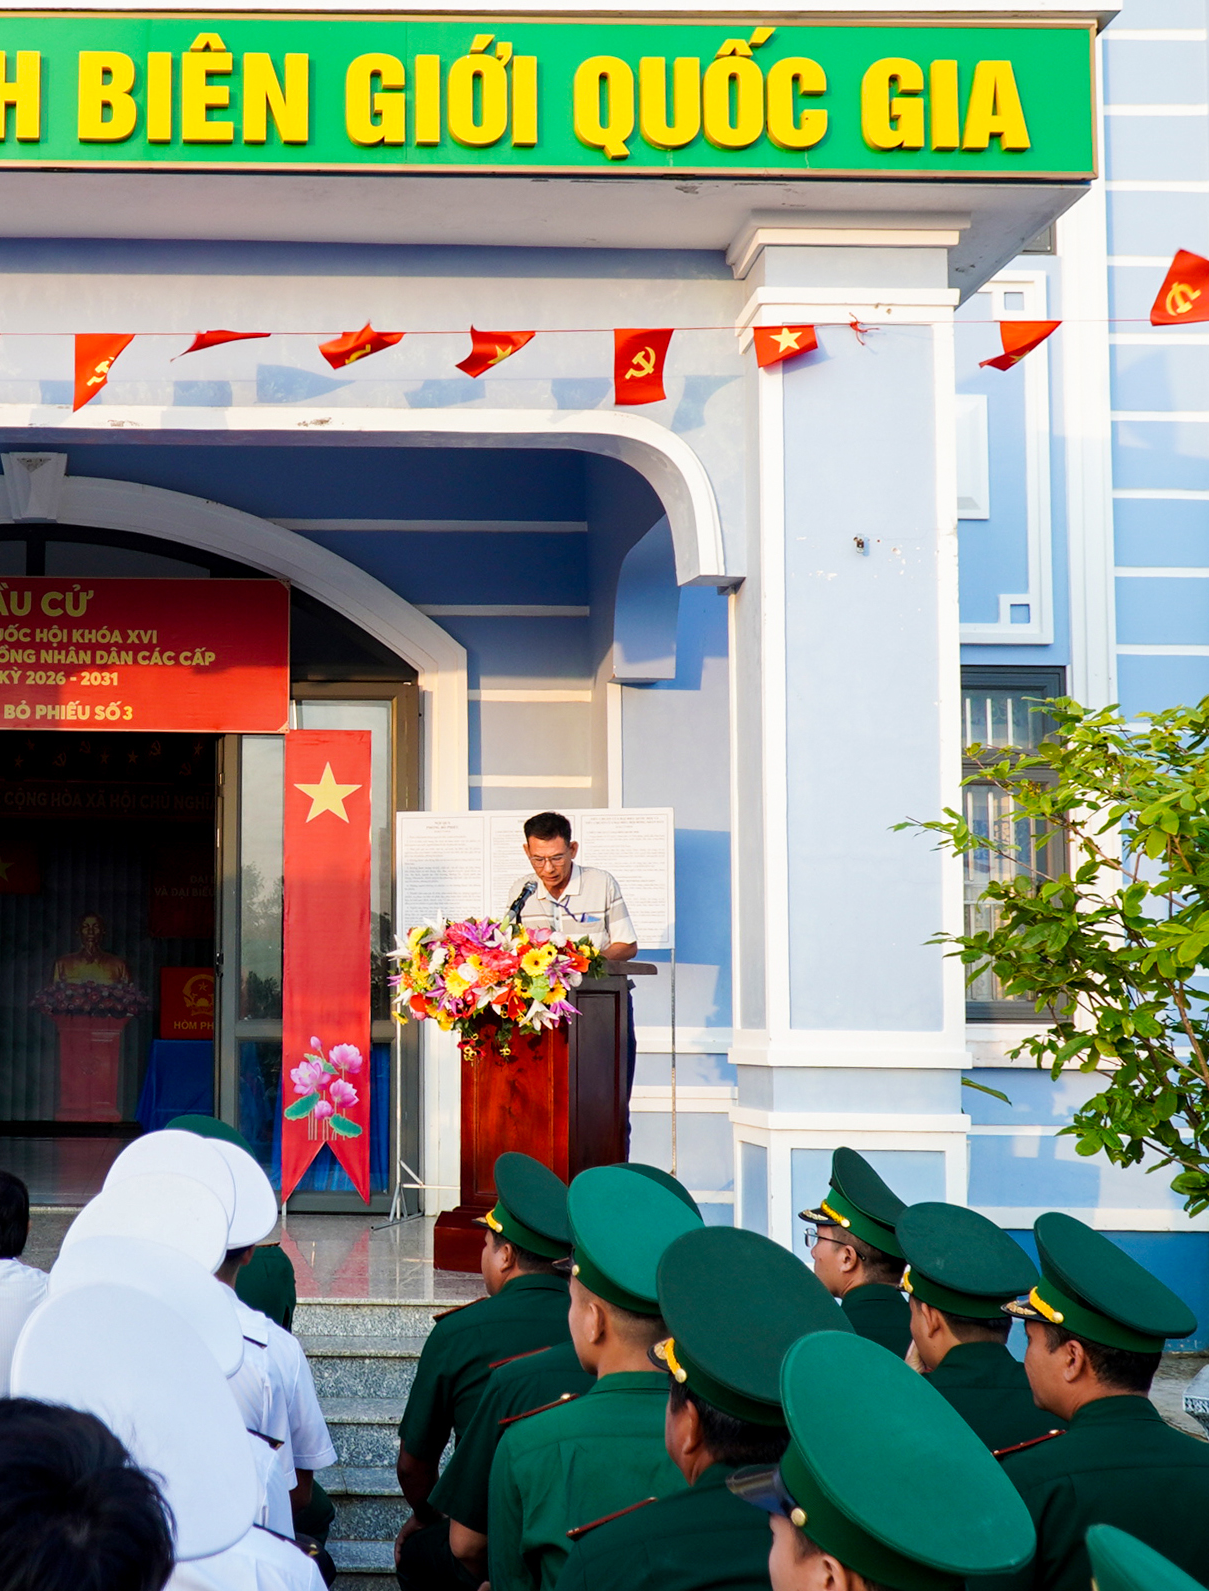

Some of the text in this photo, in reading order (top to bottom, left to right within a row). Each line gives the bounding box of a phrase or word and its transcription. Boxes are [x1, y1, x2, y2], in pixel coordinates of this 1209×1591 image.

[78, 33, 310, 145] BIÊN
[345, 34, 539, 149] GIỚI
[574, 26, 829, 160] QUỐC
[861, 57, 1032, 152] GIA
[40, 584, 94, 617] CỬ
[35, 625, 68, 647] HỘI
[72, 626, 123, 644] KHÓA
[126, 629, 158, 644] XVI
[40, 646, 91, 664] NHÂN
[95, 647, 133, 665] DÂN
[137, 647, 175, 666] CÁC
[179, 647, 216, 666] CẤP
[25, 671, 66, 685] 2026
[80, 671, 118, 686] 2031
[3, 700, 32, 720] BỎ
[35, 700, 91, 720] PHIẾU
[94, 701, 122, 721] SỐ
[122, 706, 133, 720] 3
[4, 788, 47, 811] CỘNG
[50, 788, 81, 808] HÒA
[86, 790, 106, 809] XÃ
[109, 790, 137, 813] HỘI
[140, 791, 170, 810] CHỦ
[173, 1019, 197, 1030] HÒM
